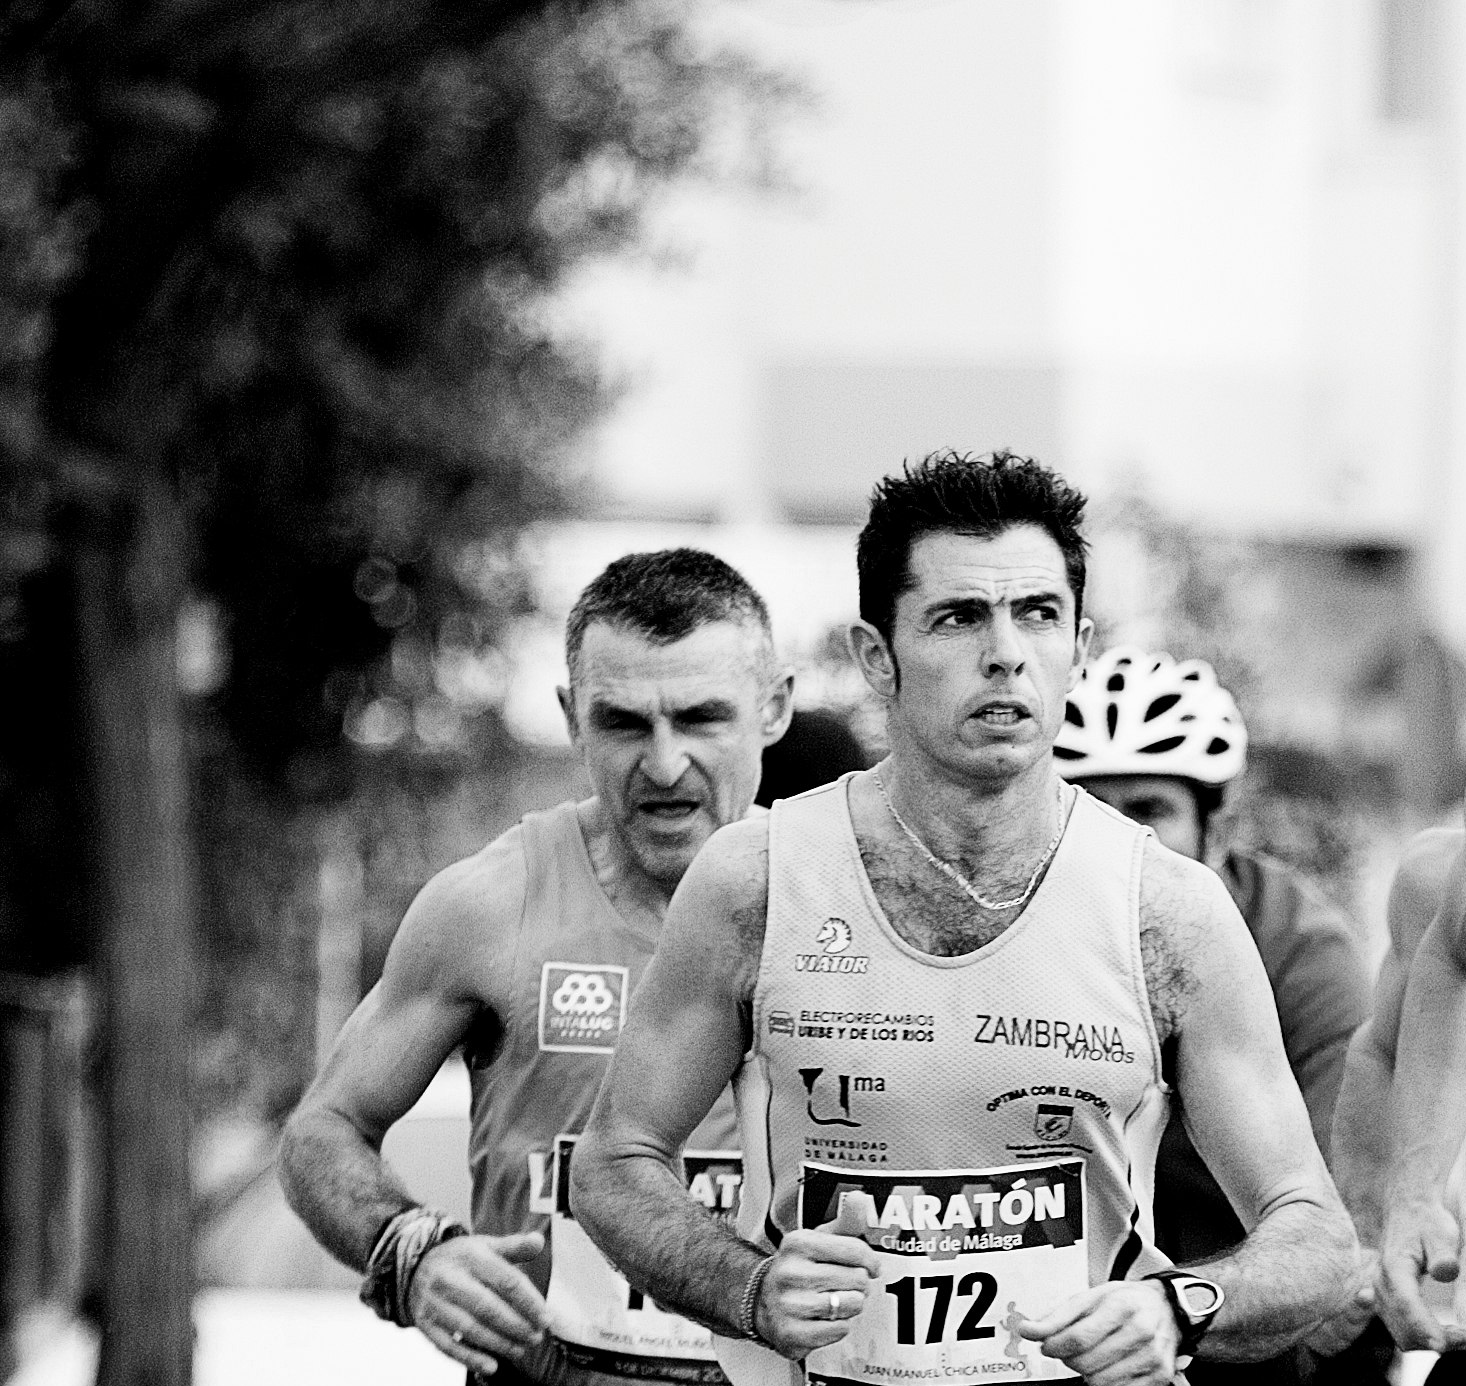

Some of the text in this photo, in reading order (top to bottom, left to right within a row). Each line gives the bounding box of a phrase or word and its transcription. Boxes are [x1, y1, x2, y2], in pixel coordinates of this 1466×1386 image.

[794, 953, 869, 973] VIATOR
[837, 1027, 847, 1039] Y
[849, 1027, 868, 1040] DE
[871, 1028, 898, 1041] LOS
[902, 1029, 935, 1043] RIOS
[974, 1014, 1125, 1056] ZAMBRANA
[1030, 1085, 1056, 1096] CON
[1058, 1086, 1073, 1098] EL
[804, 1137, 889, 1151] UNIVERSIDAD
[804, 1149, 822, 1159] DE
[879, 1232, 1023, 1253] Ciudad de Málaga
[885, 1271, 999, 1346] 172
[702, 1367, 725, 1383] 20
[863, 1360, 1027, 1379] JUAN MANUEL CHICA MERINO
